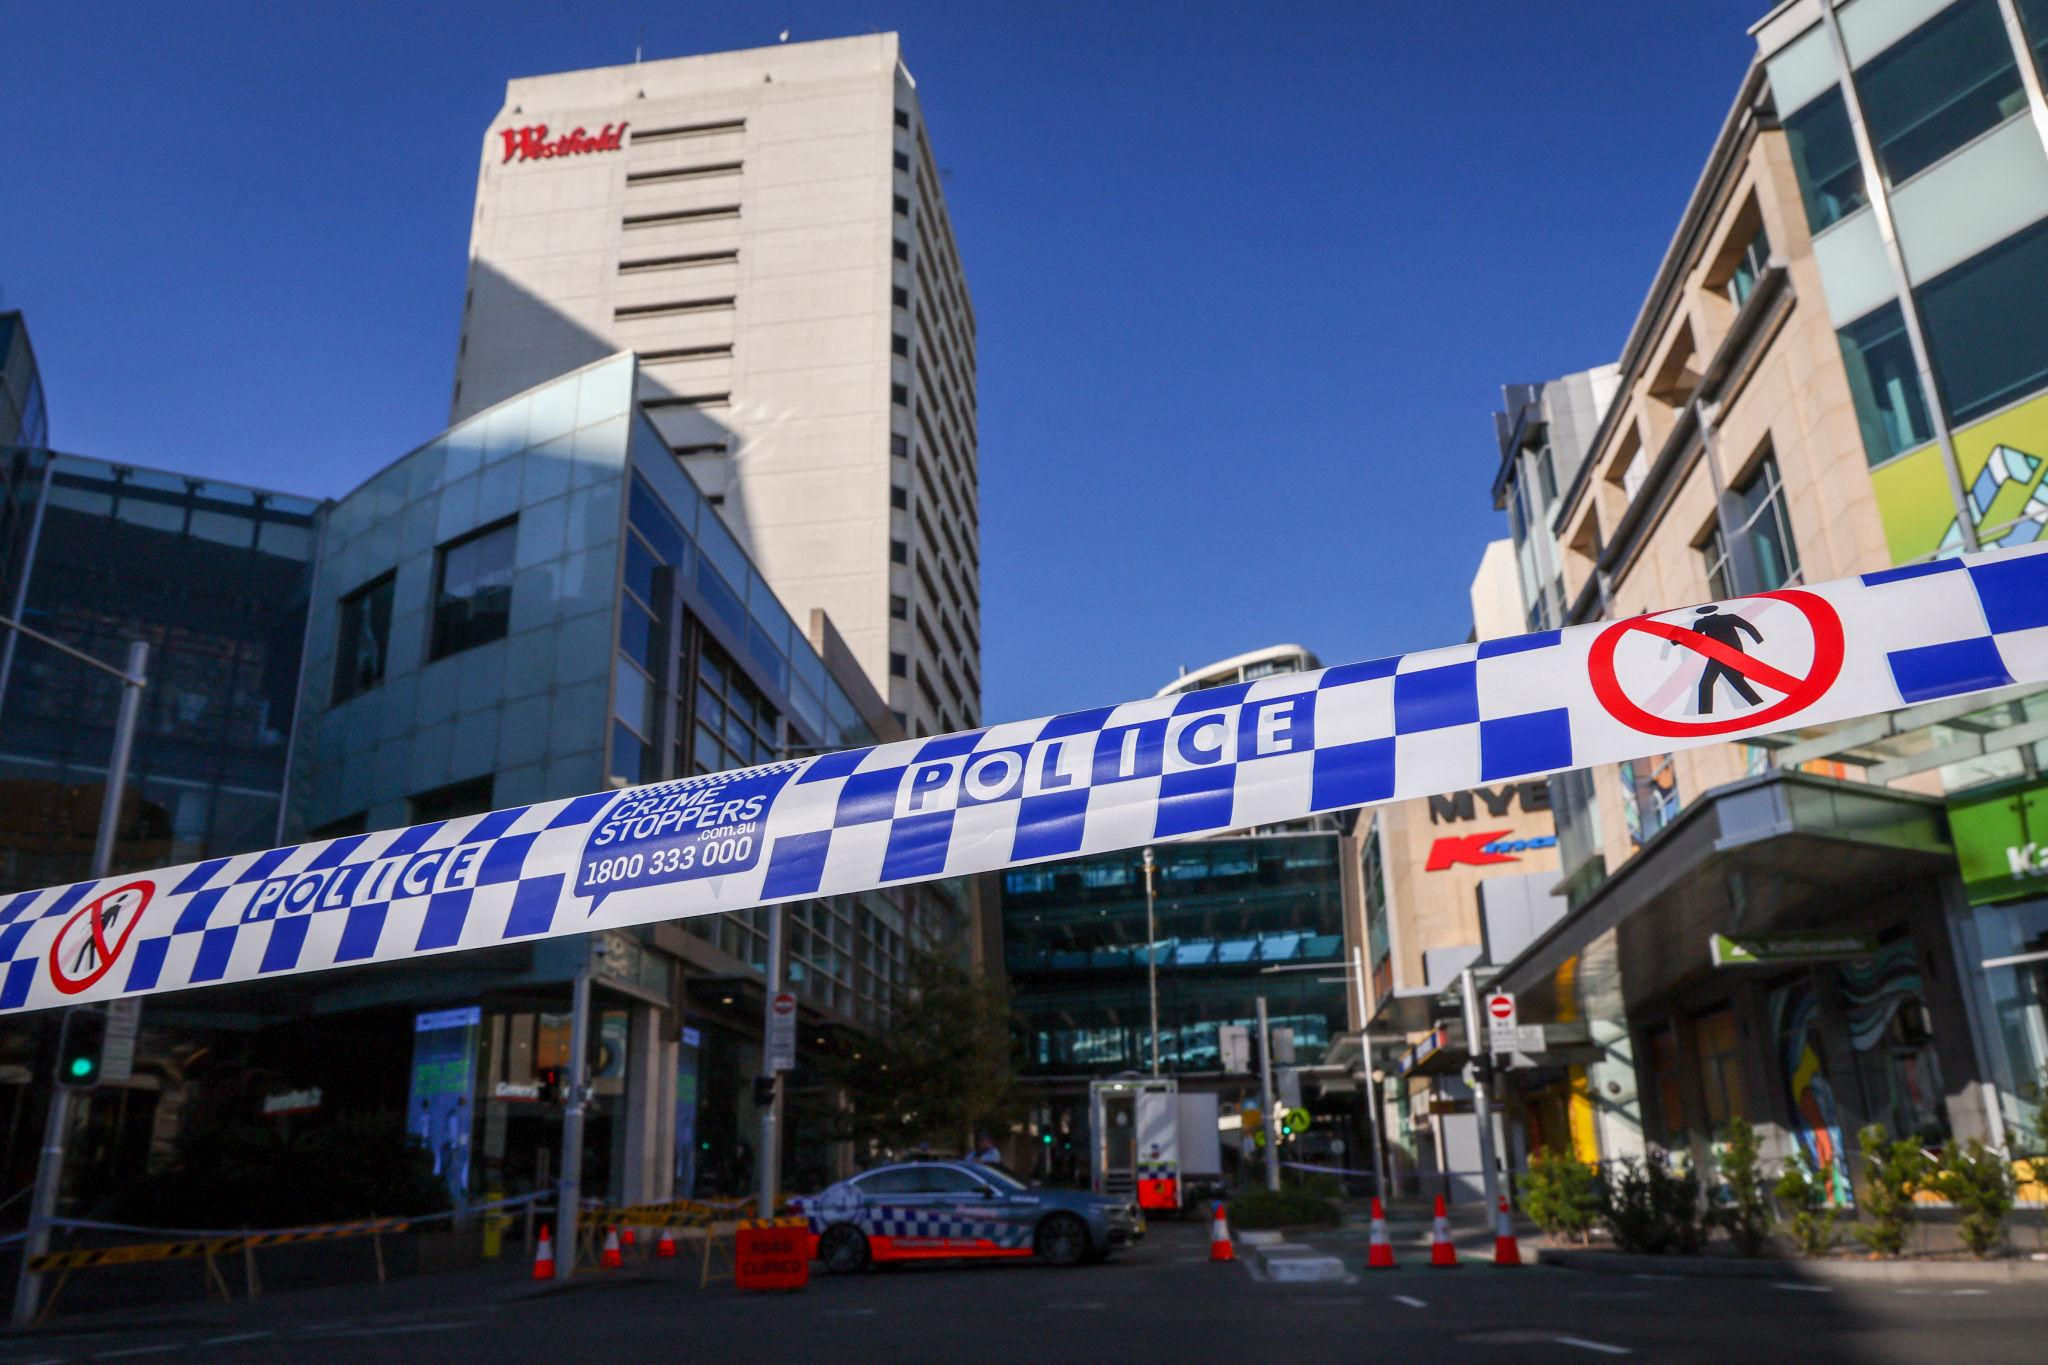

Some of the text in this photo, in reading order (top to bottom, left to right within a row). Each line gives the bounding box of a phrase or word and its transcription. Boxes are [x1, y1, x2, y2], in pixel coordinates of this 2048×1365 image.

[500, 122, 629, 164] Westfield
[907, 701, 1295, 811] POLICE
[595, 795, 767, 845] STOPPERS
[612, 786, 727, 821] CRIME
[697, 821, 756, 842] .com.au
[249, 845, 483, 919] POLICE
[583, 836, 752, 886] 1800 333 000
